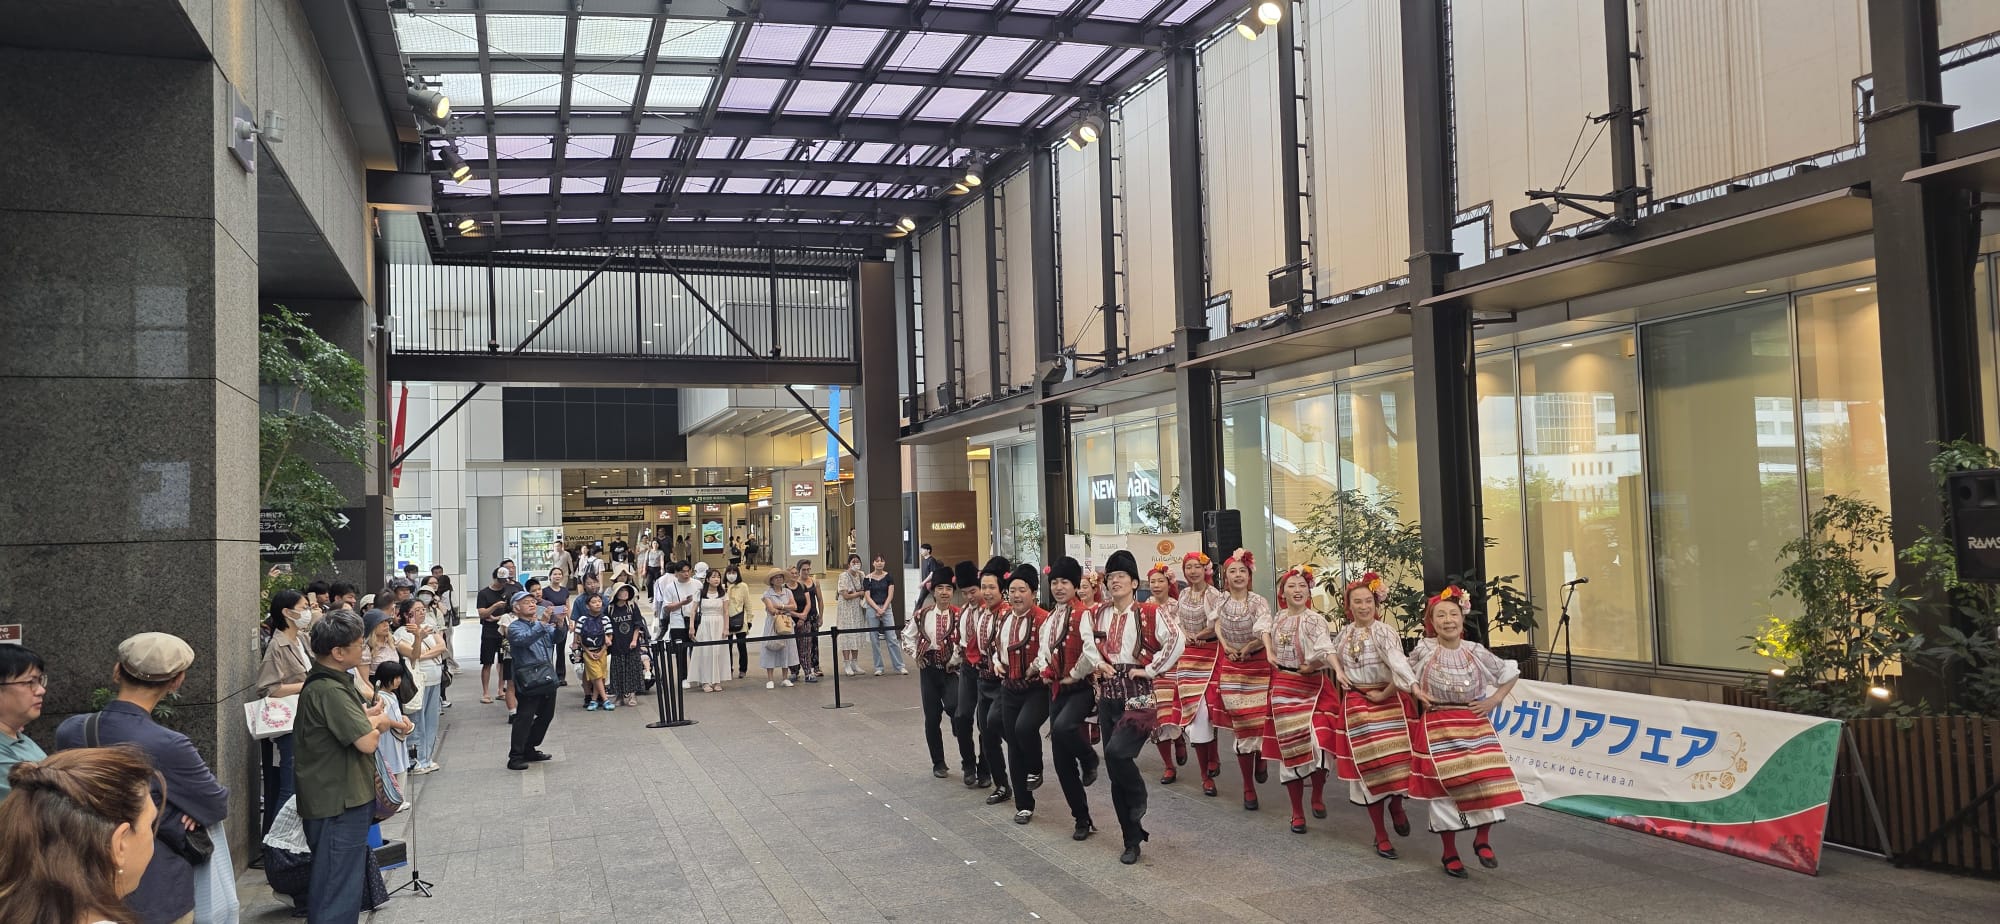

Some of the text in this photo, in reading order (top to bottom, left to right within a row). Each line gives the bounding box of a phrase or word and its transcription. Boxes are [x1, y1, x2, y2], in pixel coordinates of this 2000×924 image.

[613, 614, 632, 623] YALE
[1505, 752, 1635, 788] ългарски фестивал
